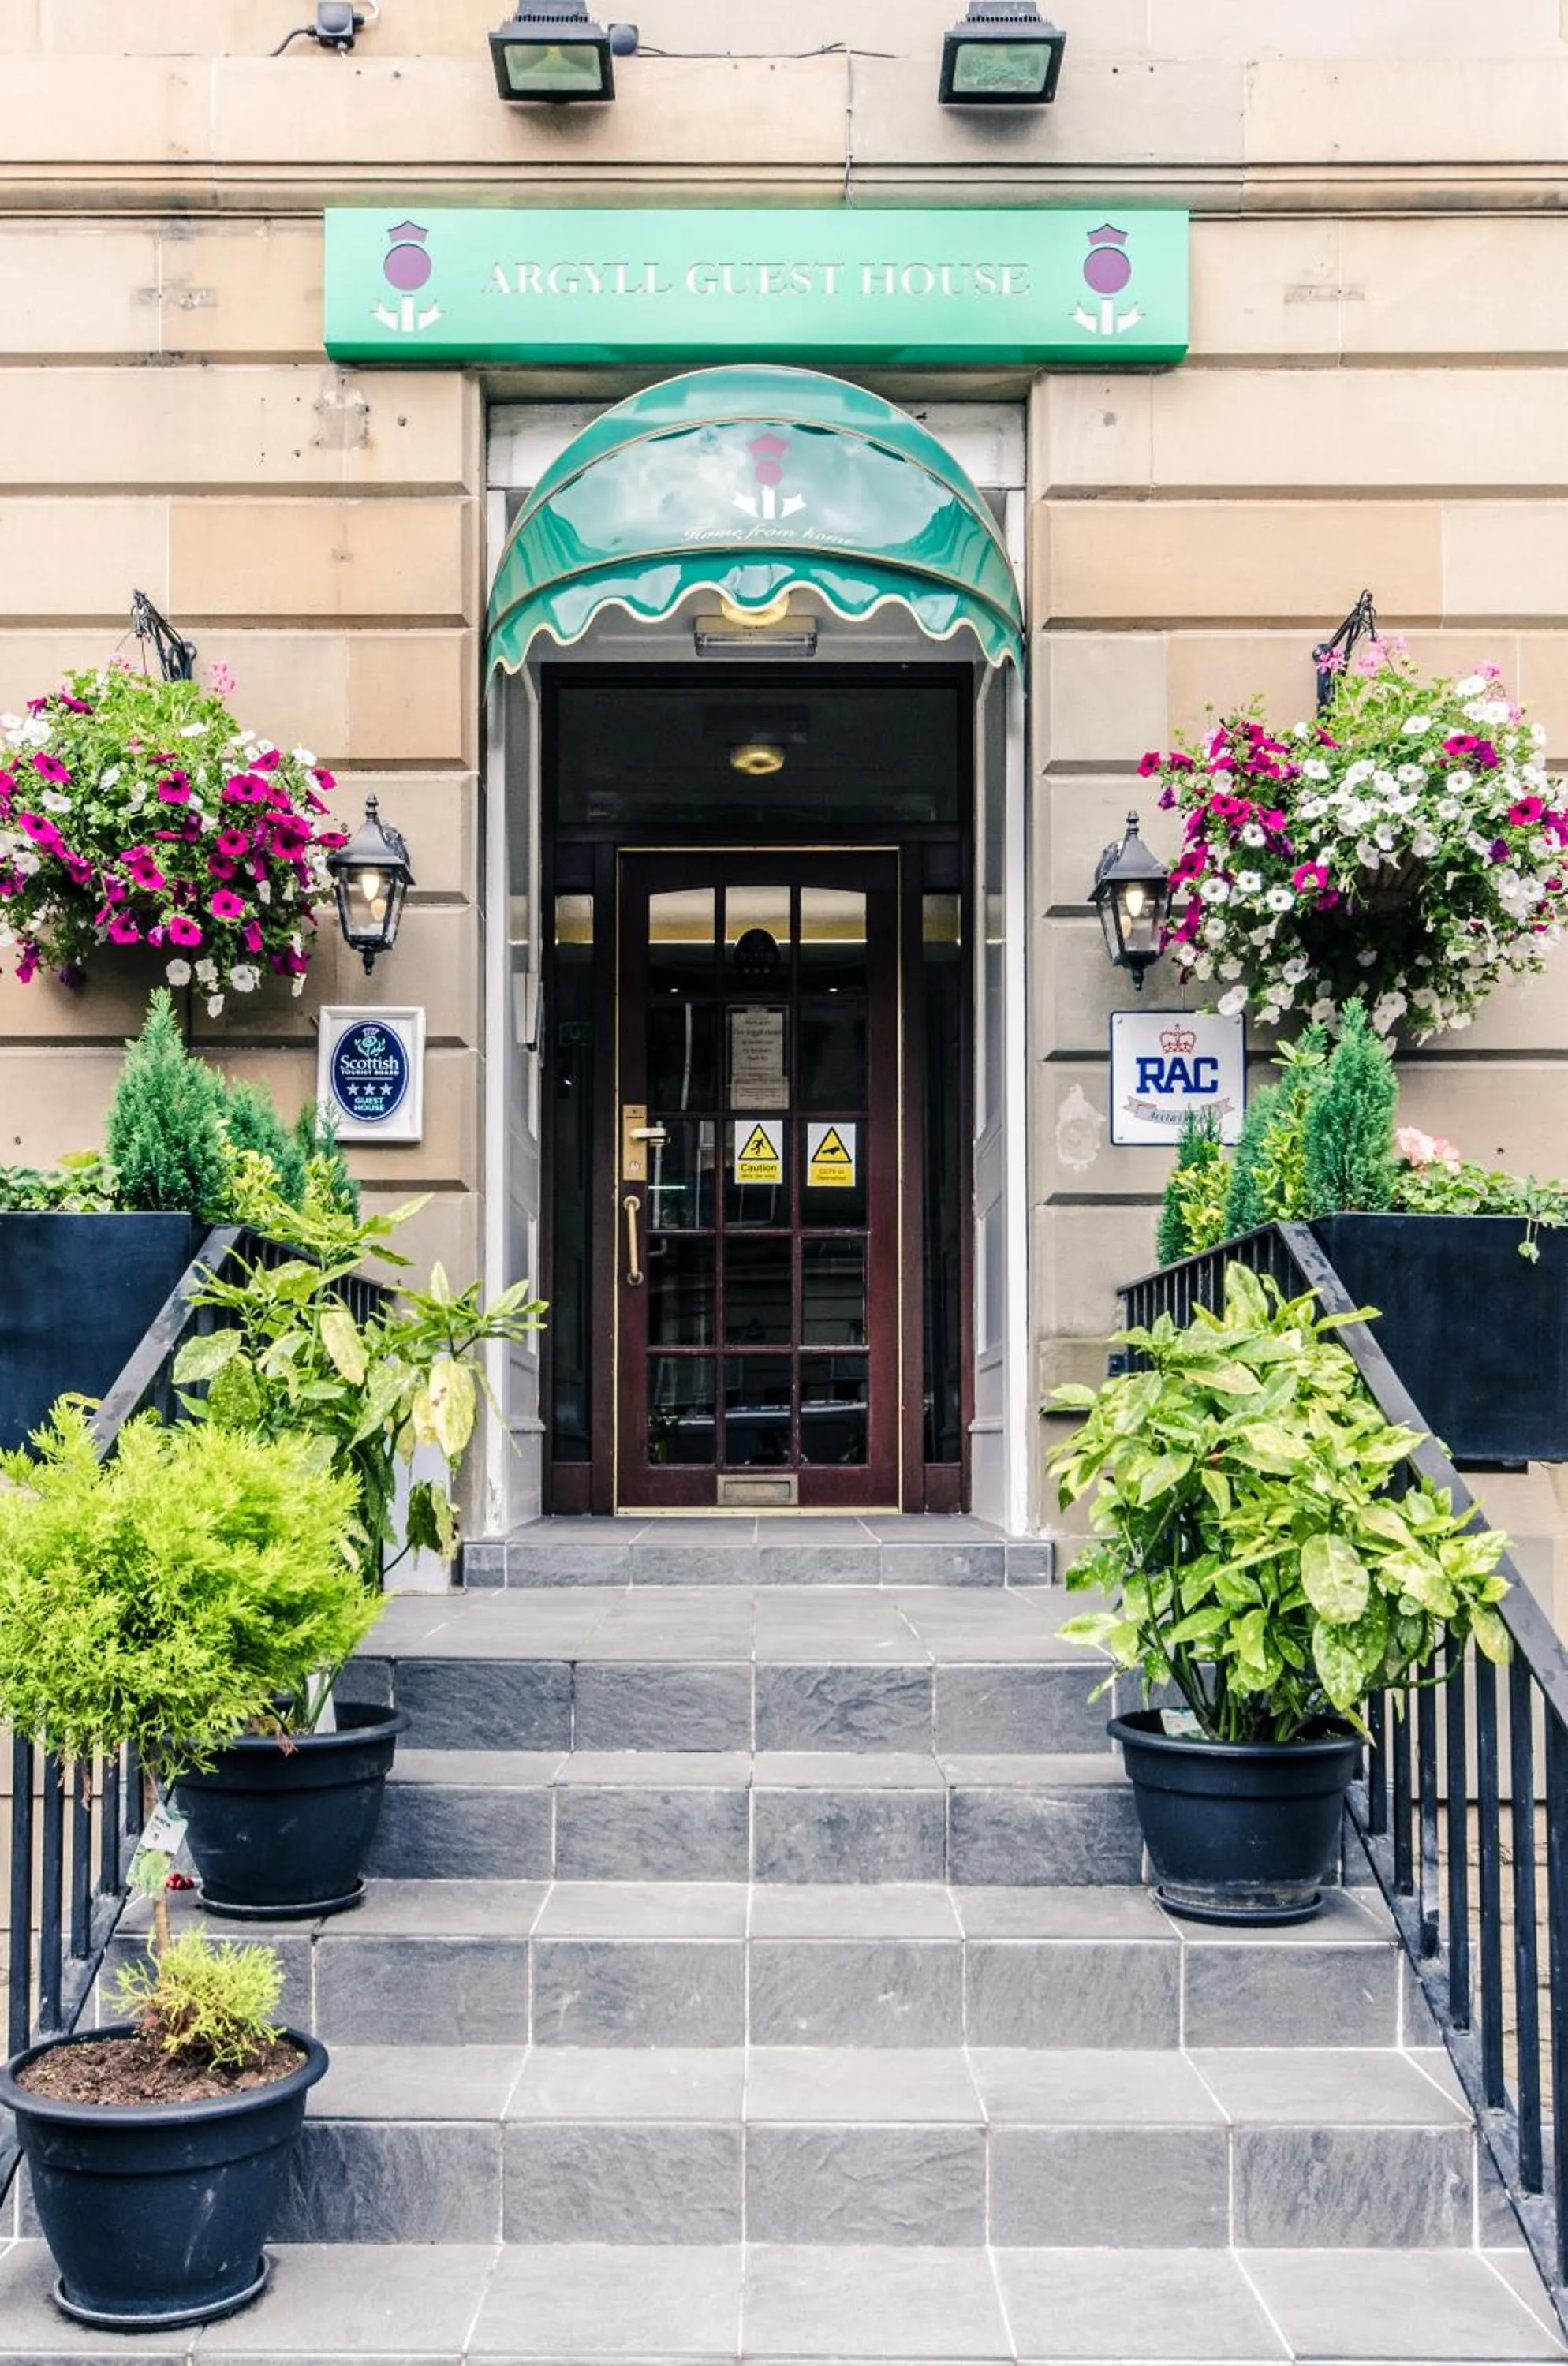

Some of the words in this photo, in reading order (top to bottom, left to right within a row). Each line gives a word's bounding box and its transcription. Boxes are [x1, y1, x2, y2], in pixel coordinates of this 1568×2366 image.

[481, 262, 672, 294] ARGYLL
[685, 262, 844, 295] GUEST
[858, 262, 1031, 296] HOUSE
[683, 528, 745, 541] Home
[745, 524, 794, 540] from
[801, 527, 856, 544] home
[340, 1055, 399, 1070] Scottish
[1136, 1057, 1219, 1093] RAC
[741, 1163, 777, 1172] Caution
